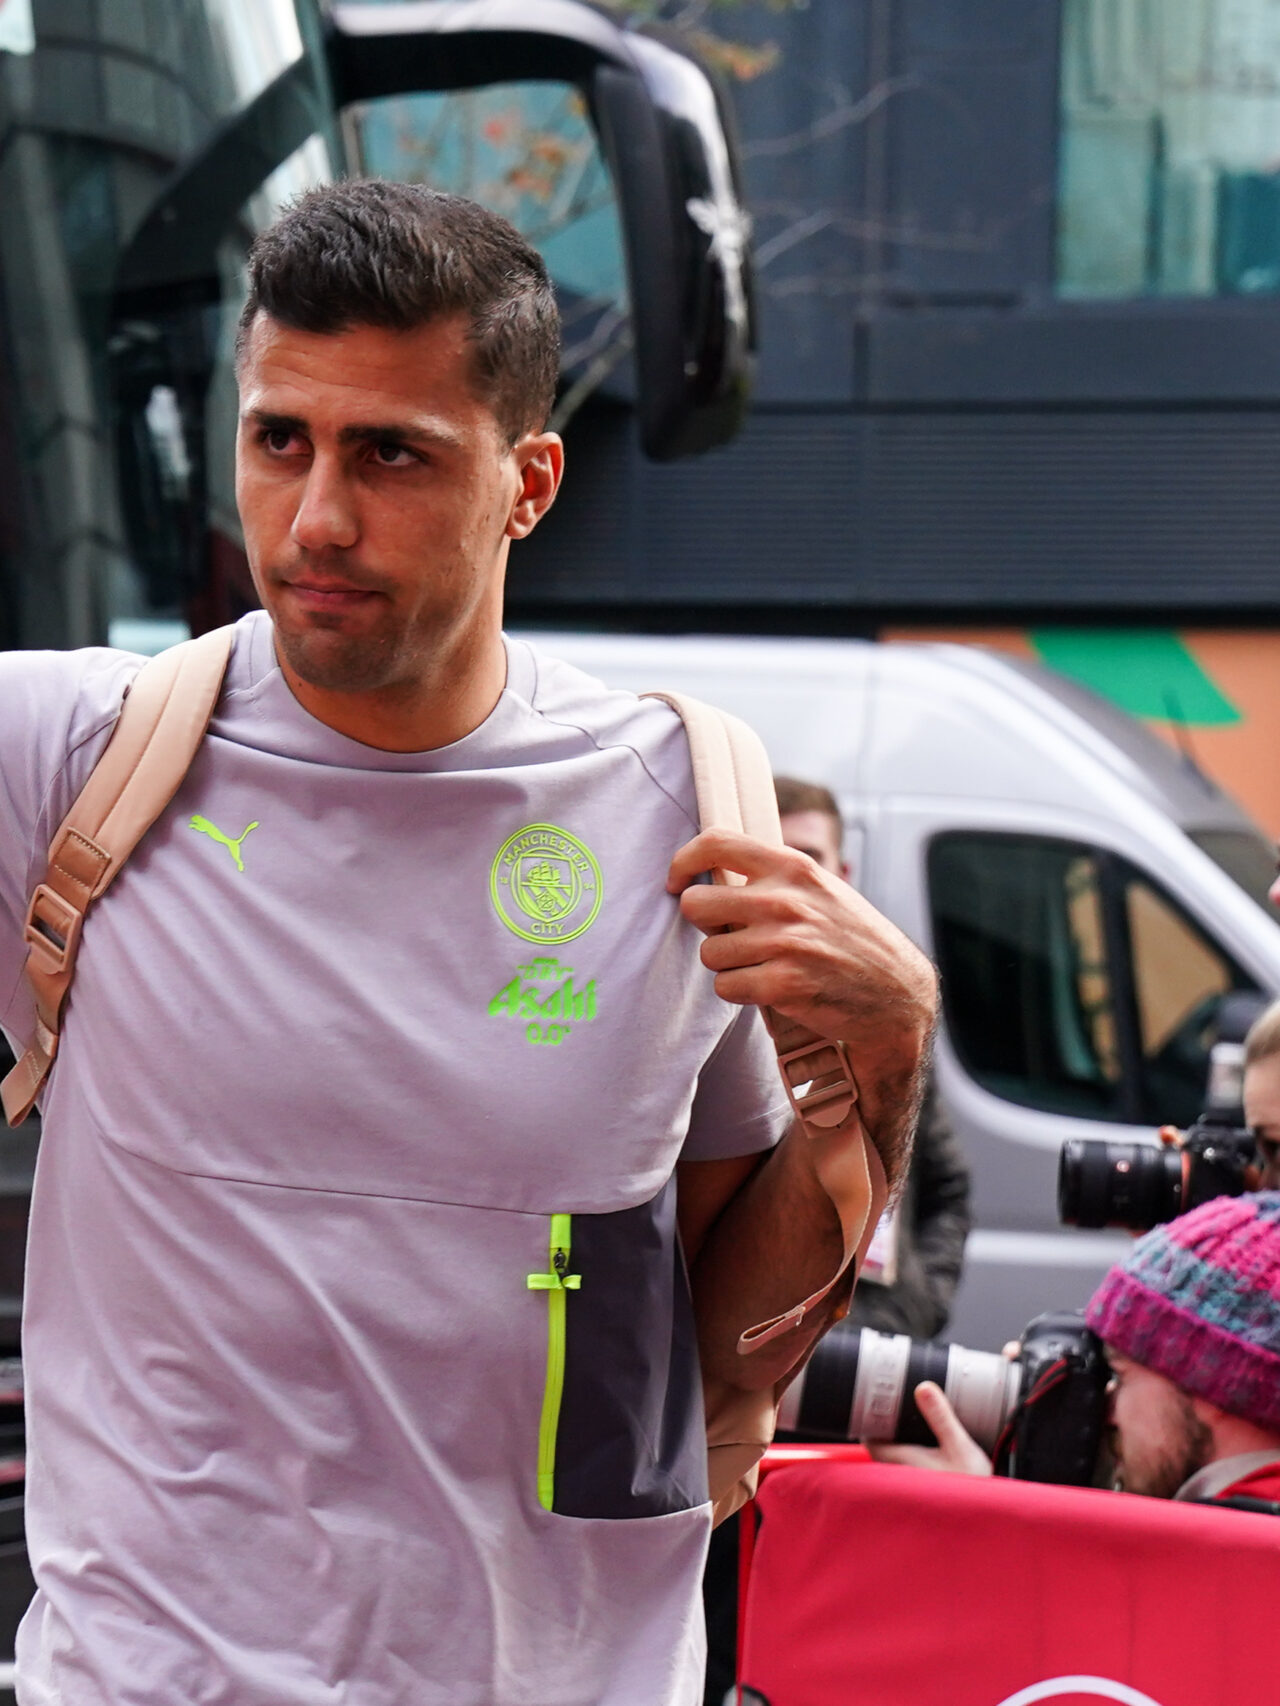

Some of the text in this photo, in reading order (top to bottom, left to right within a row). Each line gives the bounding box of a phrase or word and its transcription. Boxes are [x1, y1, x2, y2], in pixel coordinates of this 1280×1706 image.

[503, 833, 591, 872] MANCHESTER
[530, 922, 566, 935] CITY
[487, 975, 598, 1022] Asahi
